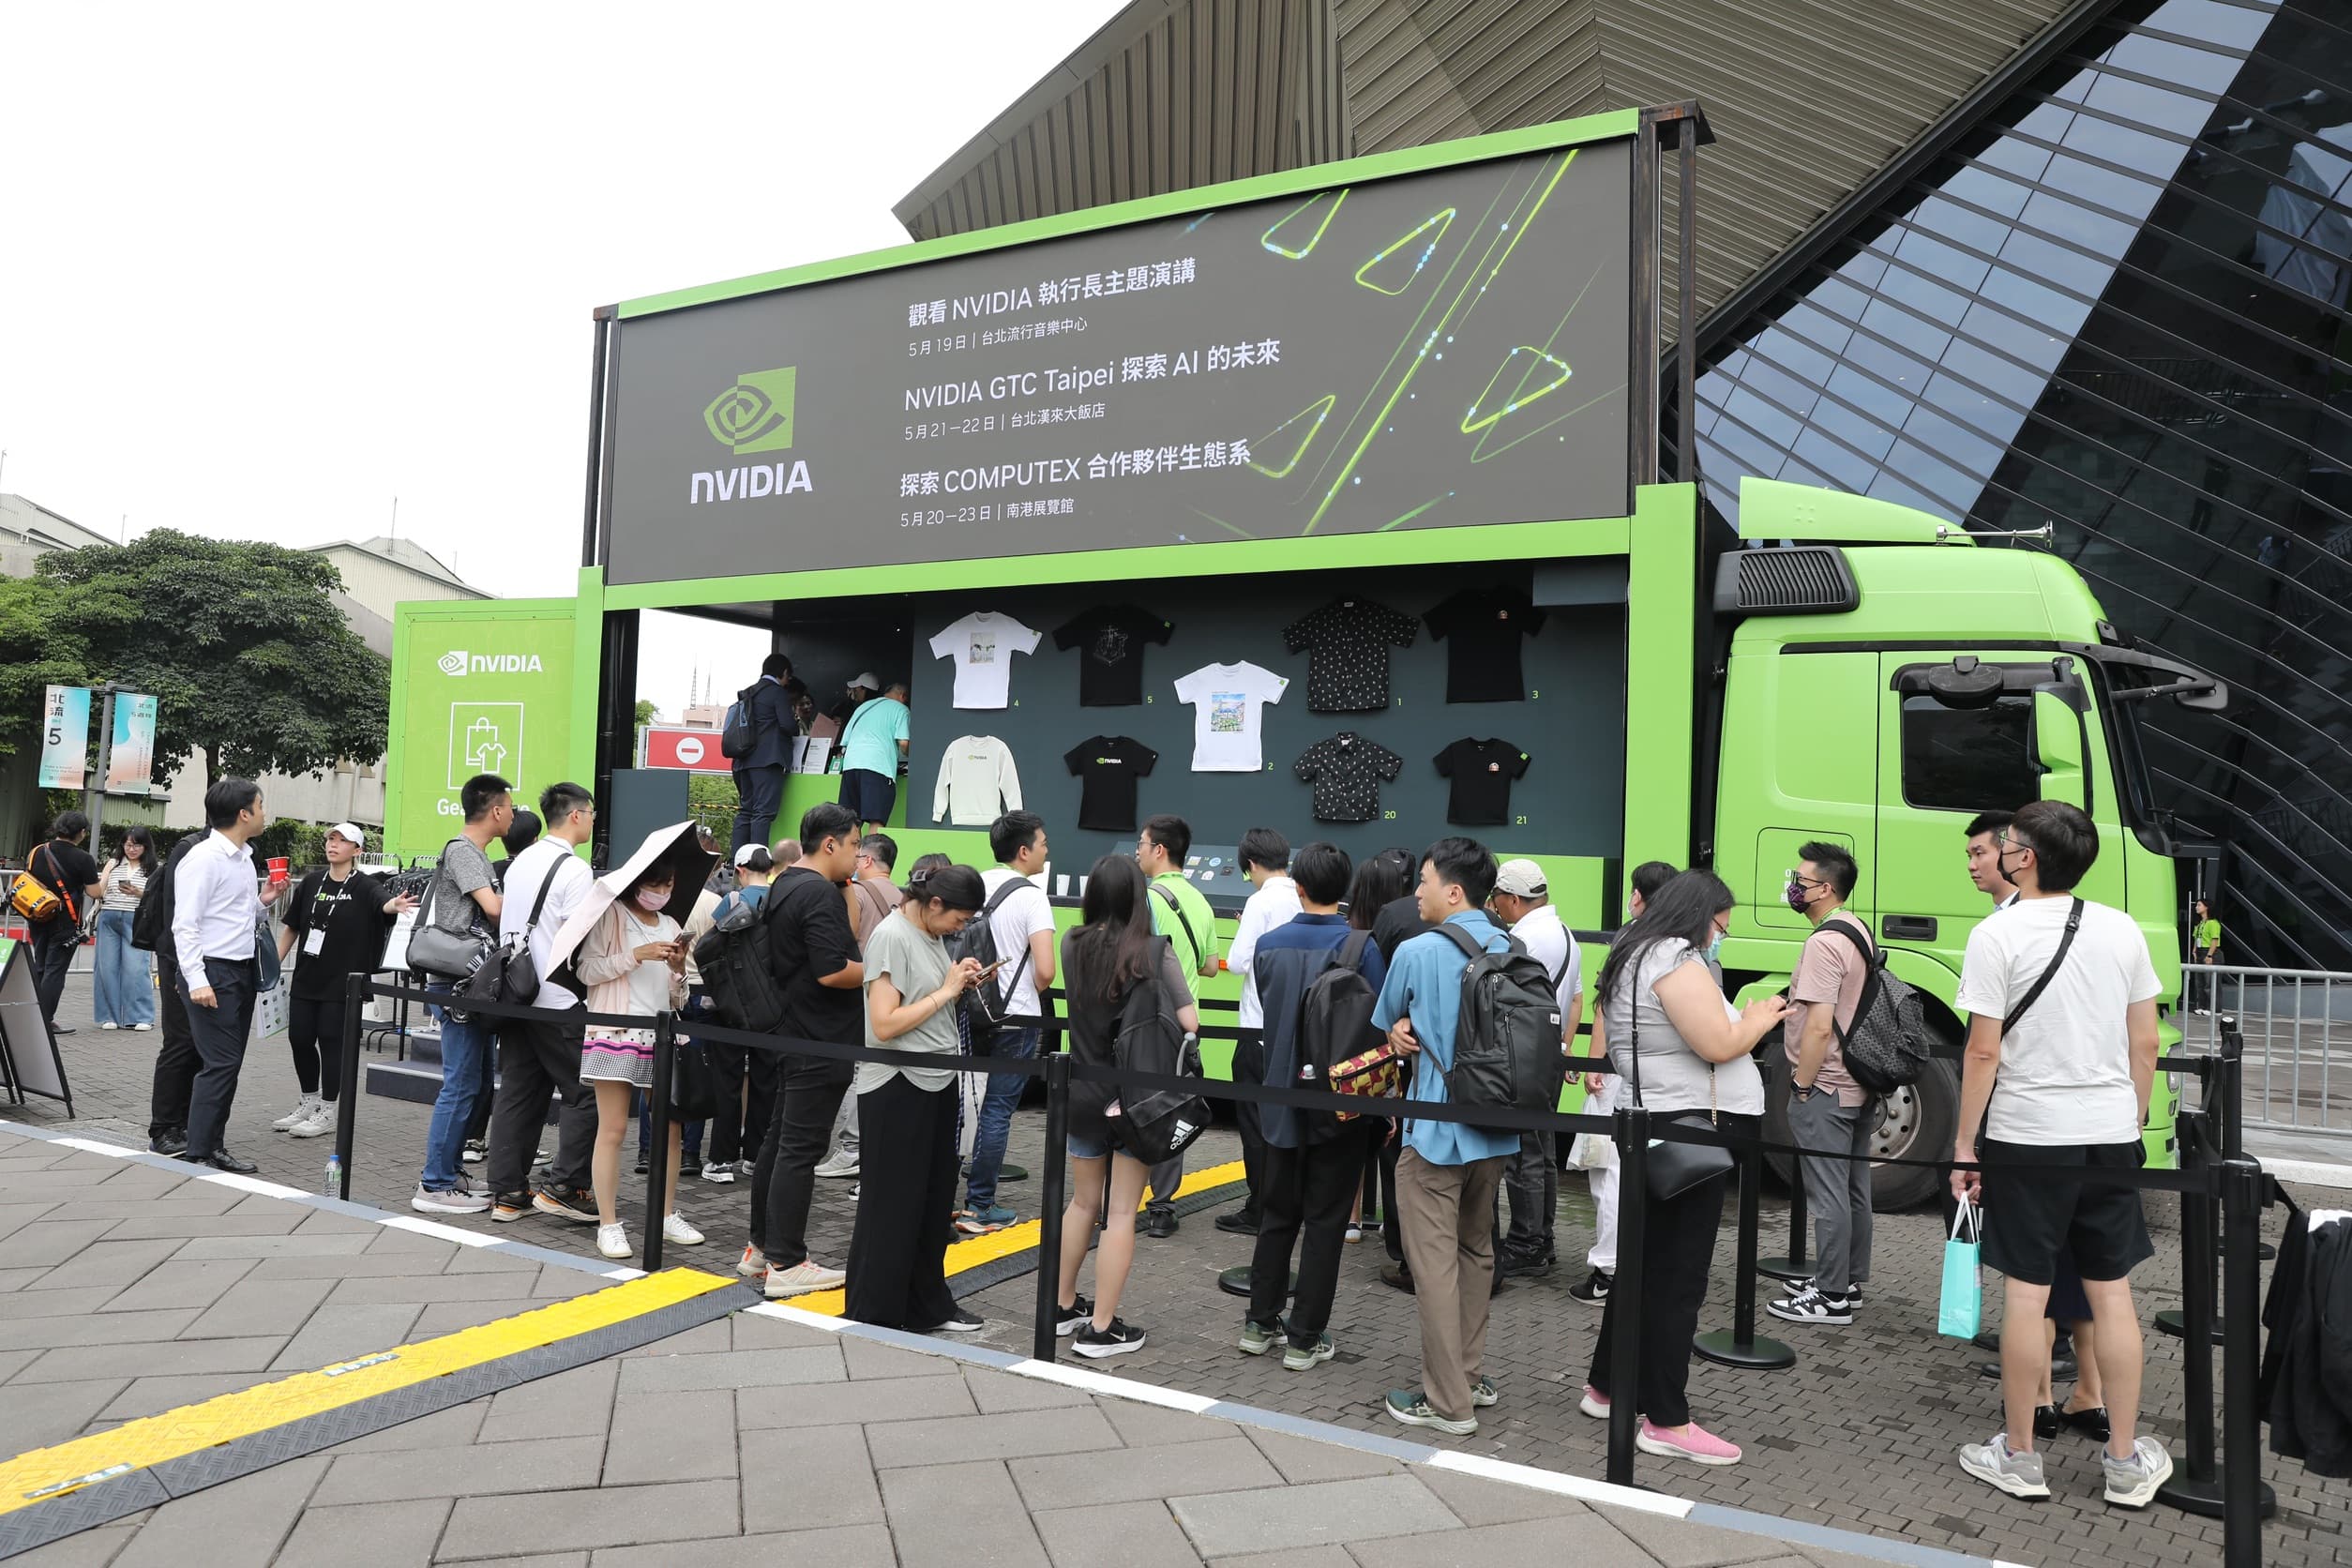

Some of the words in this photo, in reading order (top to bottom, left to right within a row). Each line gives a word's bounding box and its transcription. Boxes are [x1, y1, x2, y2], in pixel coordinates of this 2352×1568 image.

[908, 298, 948, 328] 觀看
[952, 286, 1033, 321] NVIDIA
[1037, 256, 1197, 307] 執行長主題演講
[982, 316, 1088, 346] 台北流行音樂中心
[904, 379, 984, 412] NVIDIA
[989, 371, 1038, 400] GTC
[1043, 360, 1114, 395] Taipei
[1121, 353, 1168, 384] 探索
[1171, 350, 1199, 377] AI
[1207, 337, 1281, 372] 的未來
[1011, 401, 1107, 429] 台北漢來大飯店
[899, 470, 940, 498] 探索
[943, 457, 1081, 493] COMPUTEX
[1087, 437, 1252, 480] 合作夥伴生態系
[1006, 497, 1075, 519] 南港展覽館
[1396, 698, 1402, 706] 1
[1532, 690, 1539, 699] 3
[49, 728, 62, 746] 5
[437, 798, 466, 816] Gea
[1384, 810, 1396, 820] 20
[1515, 816, 1527, 824] 21
[1169, 1125, 1199, 1150] adid
